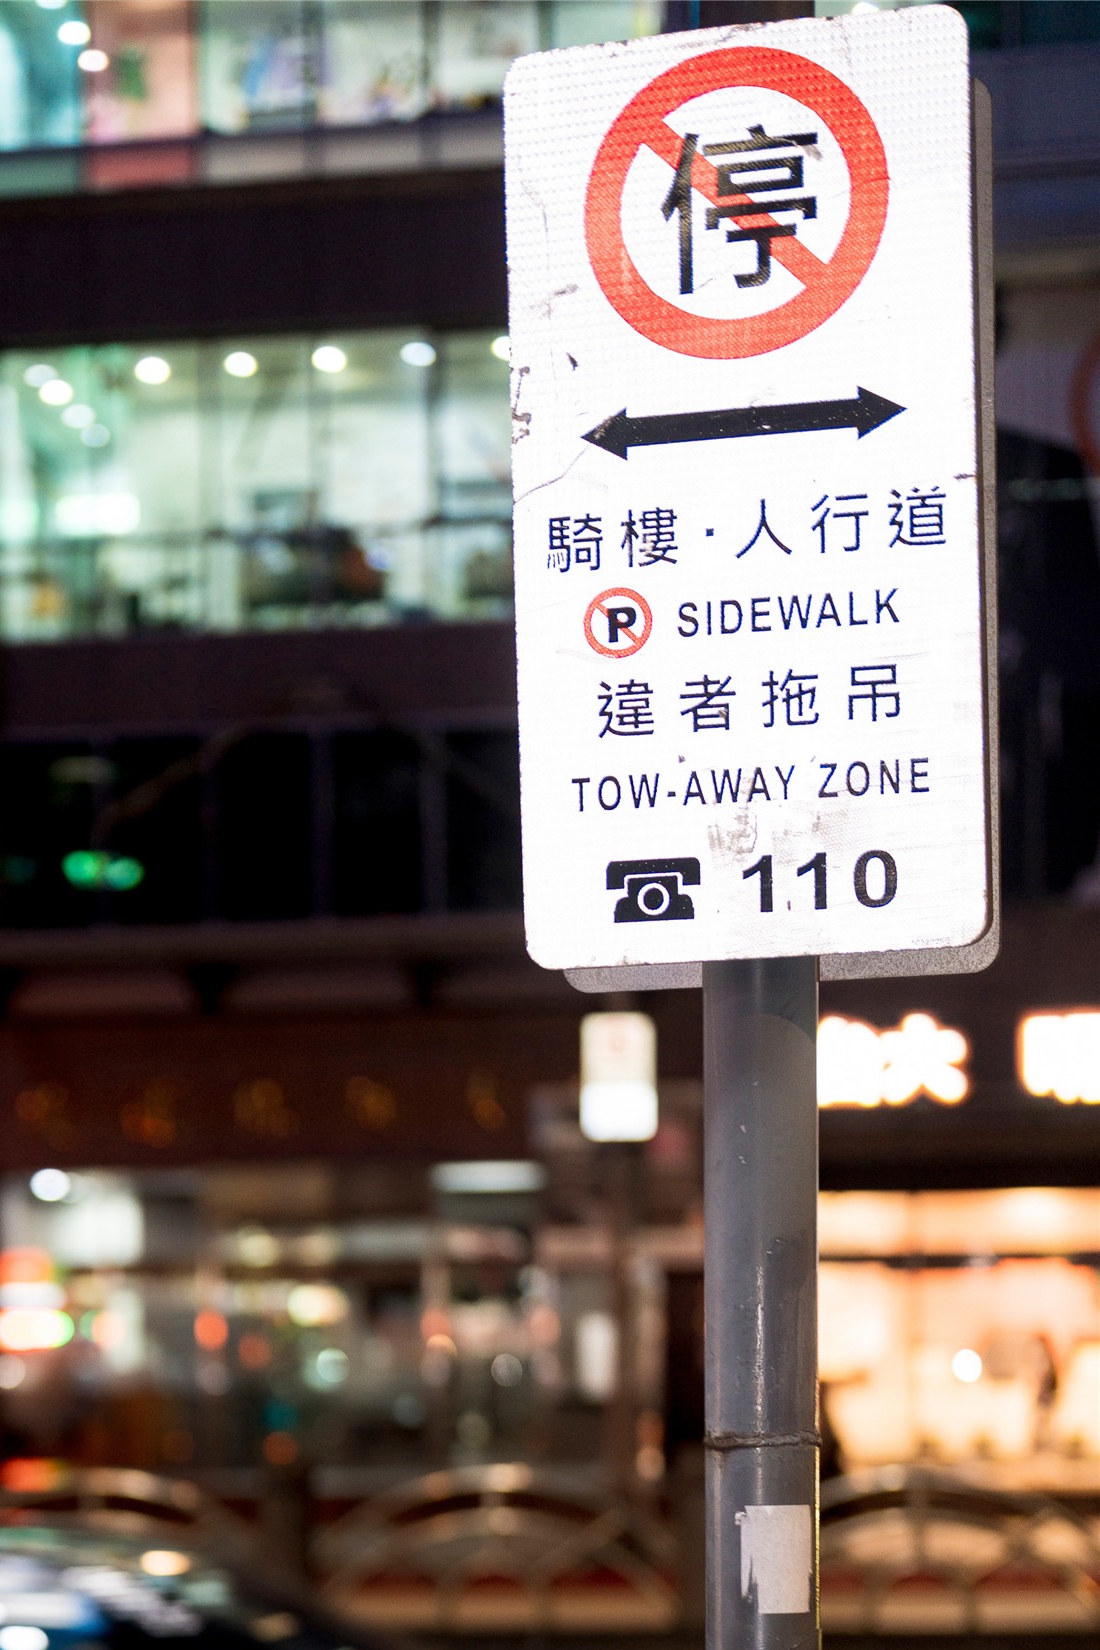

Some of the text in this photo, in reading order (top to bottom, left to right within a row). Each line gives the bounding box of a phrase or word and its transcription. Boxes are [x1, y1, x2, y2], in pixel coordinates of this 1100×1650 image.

[661, 124, 819, 295] 停
[607, 607, 637, 643] P
[677, 588, 900, 638] SIDEWALK
[597, 663, 901, 739] 違者拖吊
[571, 757, 931, 812] TOW-AWAY ZONE
[742, 850, 898, 912] 110
